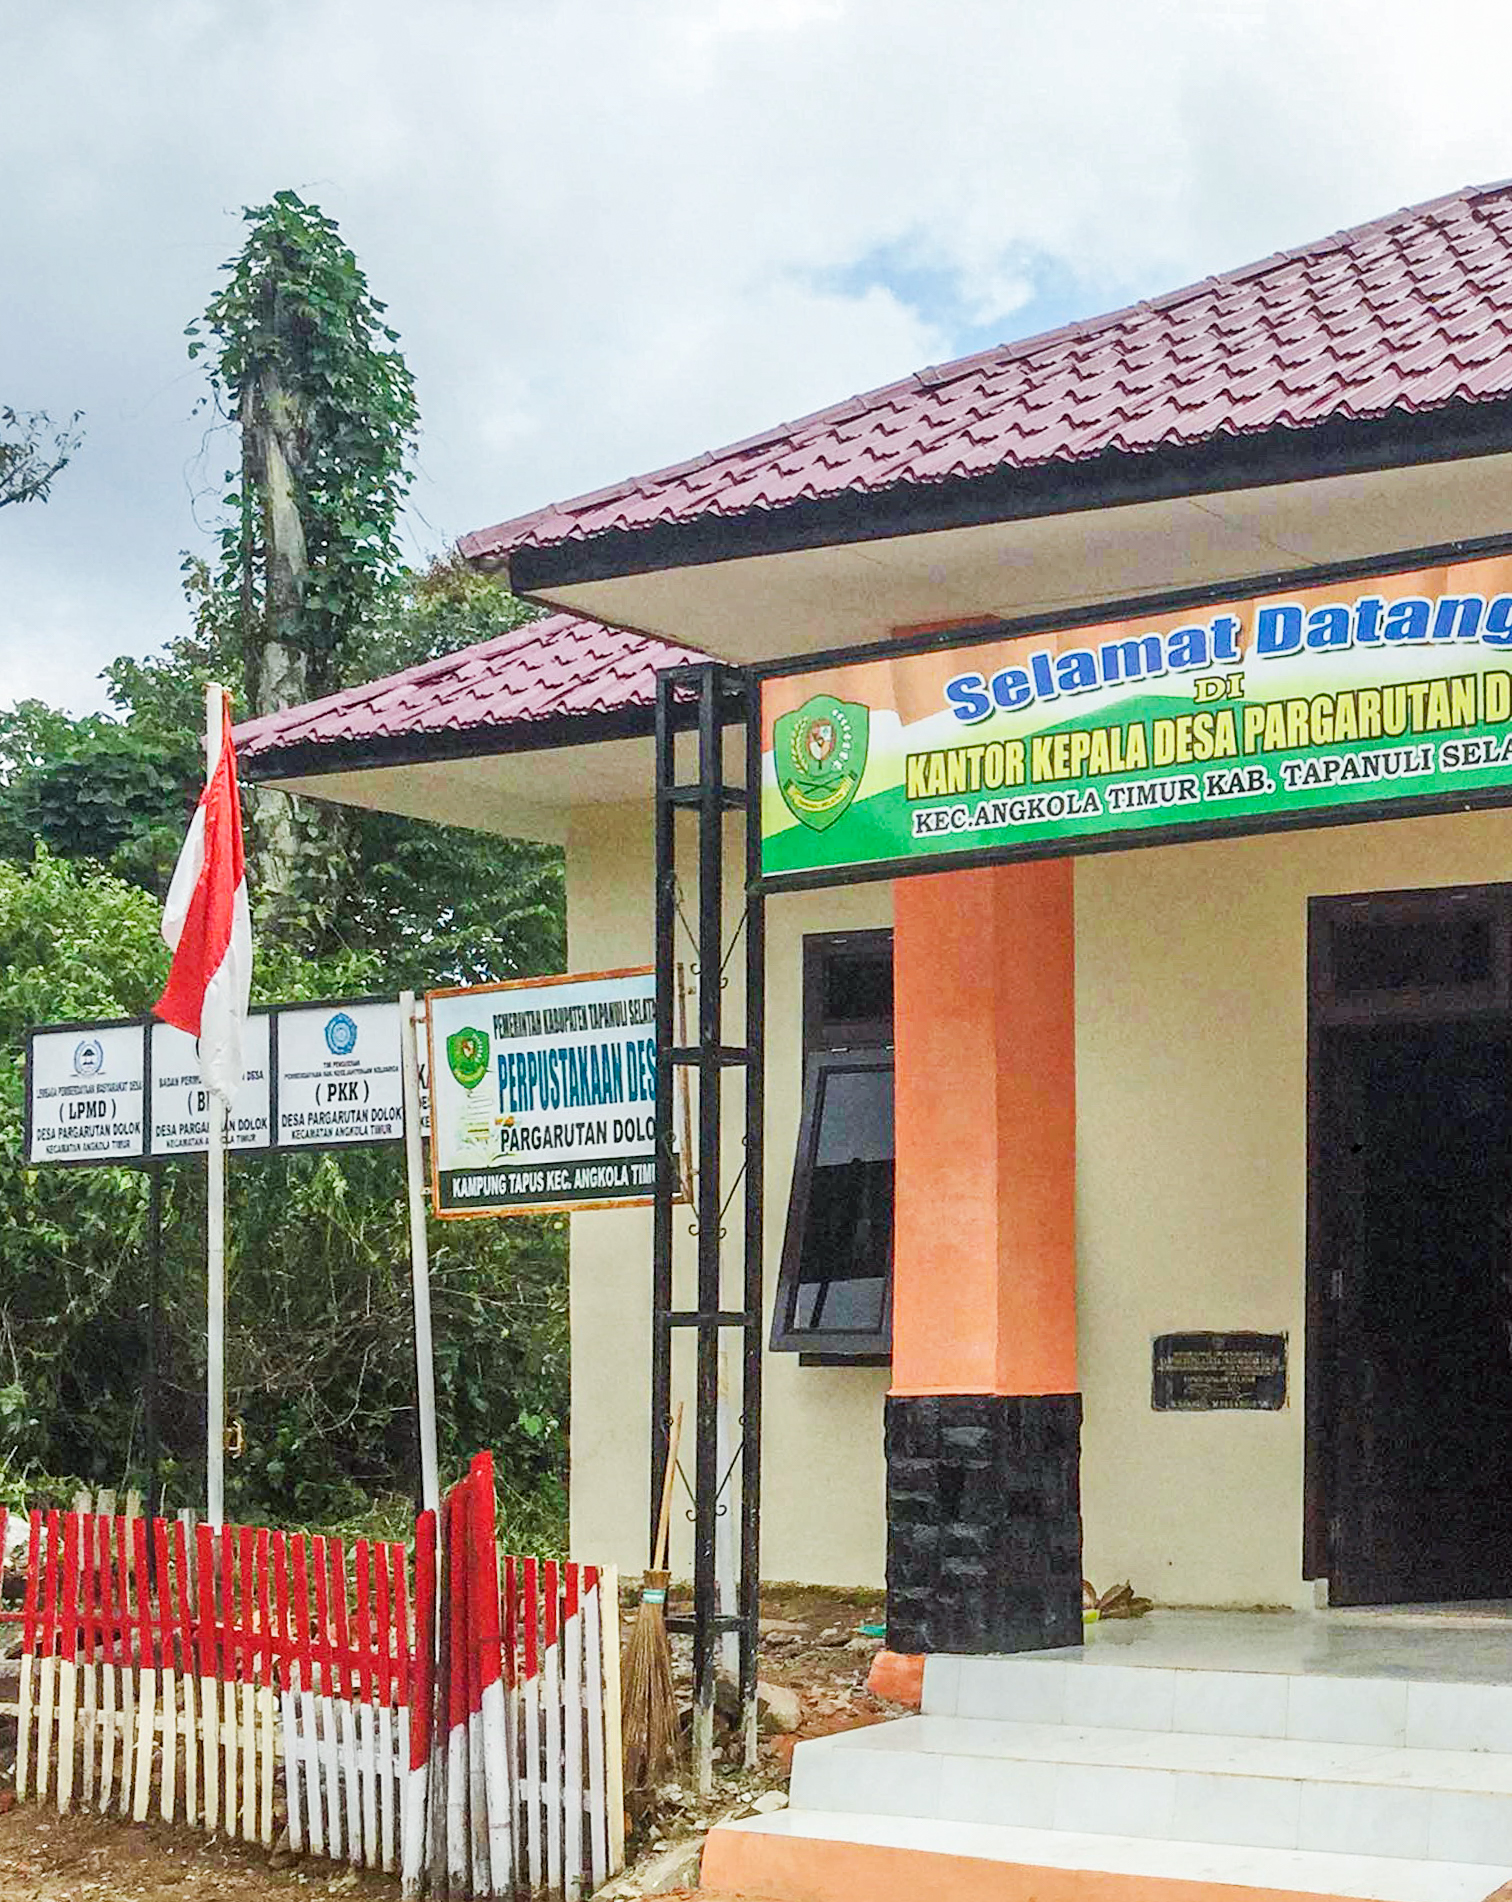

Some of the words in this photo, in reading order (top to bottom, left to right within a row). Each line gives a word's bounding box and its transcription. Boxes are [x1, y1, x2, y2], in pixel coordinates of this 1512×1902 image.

[945, 616, 1241, 723] Selamat
[1193, 672, 1245, 703] DI
[906, 740, 1025, 801] KANTOR
[1032, 723, 1147, 783] KEPALA
[1152, 709, 1238, 768] DESA
[1244, 673, 1478, 756] PARGARUTAN
[1109, 778, 1197, 808] TIMUR
[1206, 769, 1273, 798] KAB.
[1284, 748, 1431, 787] TAPANULI
[497, 1042, 624, 1114] PERPUSTAKAAN
[626, 1038, 656, 1102] DES
[37, 1127, 56, 1141] DESA
[58, 1124, 112, 1140] PARGARUTAN
[113, 1121, 141, 1136] DOLOK
[156, 1124, 177, 1137] DESA
[238, 1117, 267, 1131] DOLOK
[281, 1112, 305, 1127] DESA
[307, 1108, 369, 1126] PARGARUTAN
[371, 1106, 403, 1122] DOLOK
[500, 1120, 607, 1152] PARGARUTAN
[613, 1116, 656, 1144] DOLO
[452, 1174, 507, 1198] KAMPUNG
[508, 1171, 546, 1195] TAPUS
[546, 1169, 572, 1193] KEC.
[573, 1165, 630, 1190] ANGKOLA
[630, 1163, 656, 1186] TIM
